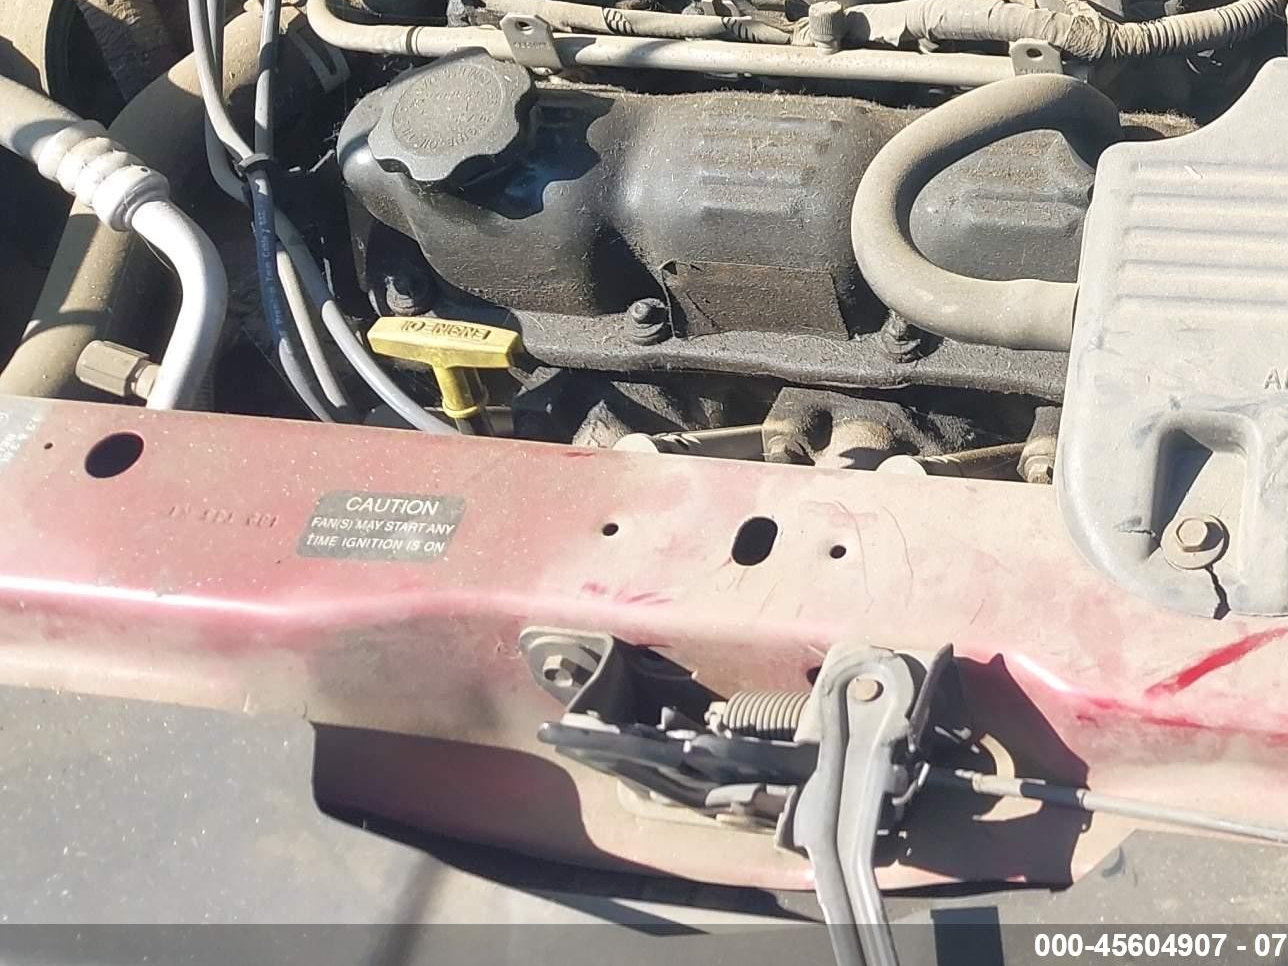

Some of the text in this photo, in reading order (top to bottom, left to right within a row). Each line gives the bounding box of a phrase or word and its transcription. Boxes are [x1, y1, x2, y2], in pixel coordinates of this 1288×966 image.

[425, 322, 492, 341] ENGINE
[346, 496, 440, 516] CAUTION
[311, 516, 456, 535] FAN(S) MAY START ANY
[306, 533, 446, 553] TIME IGNITION IS ON
